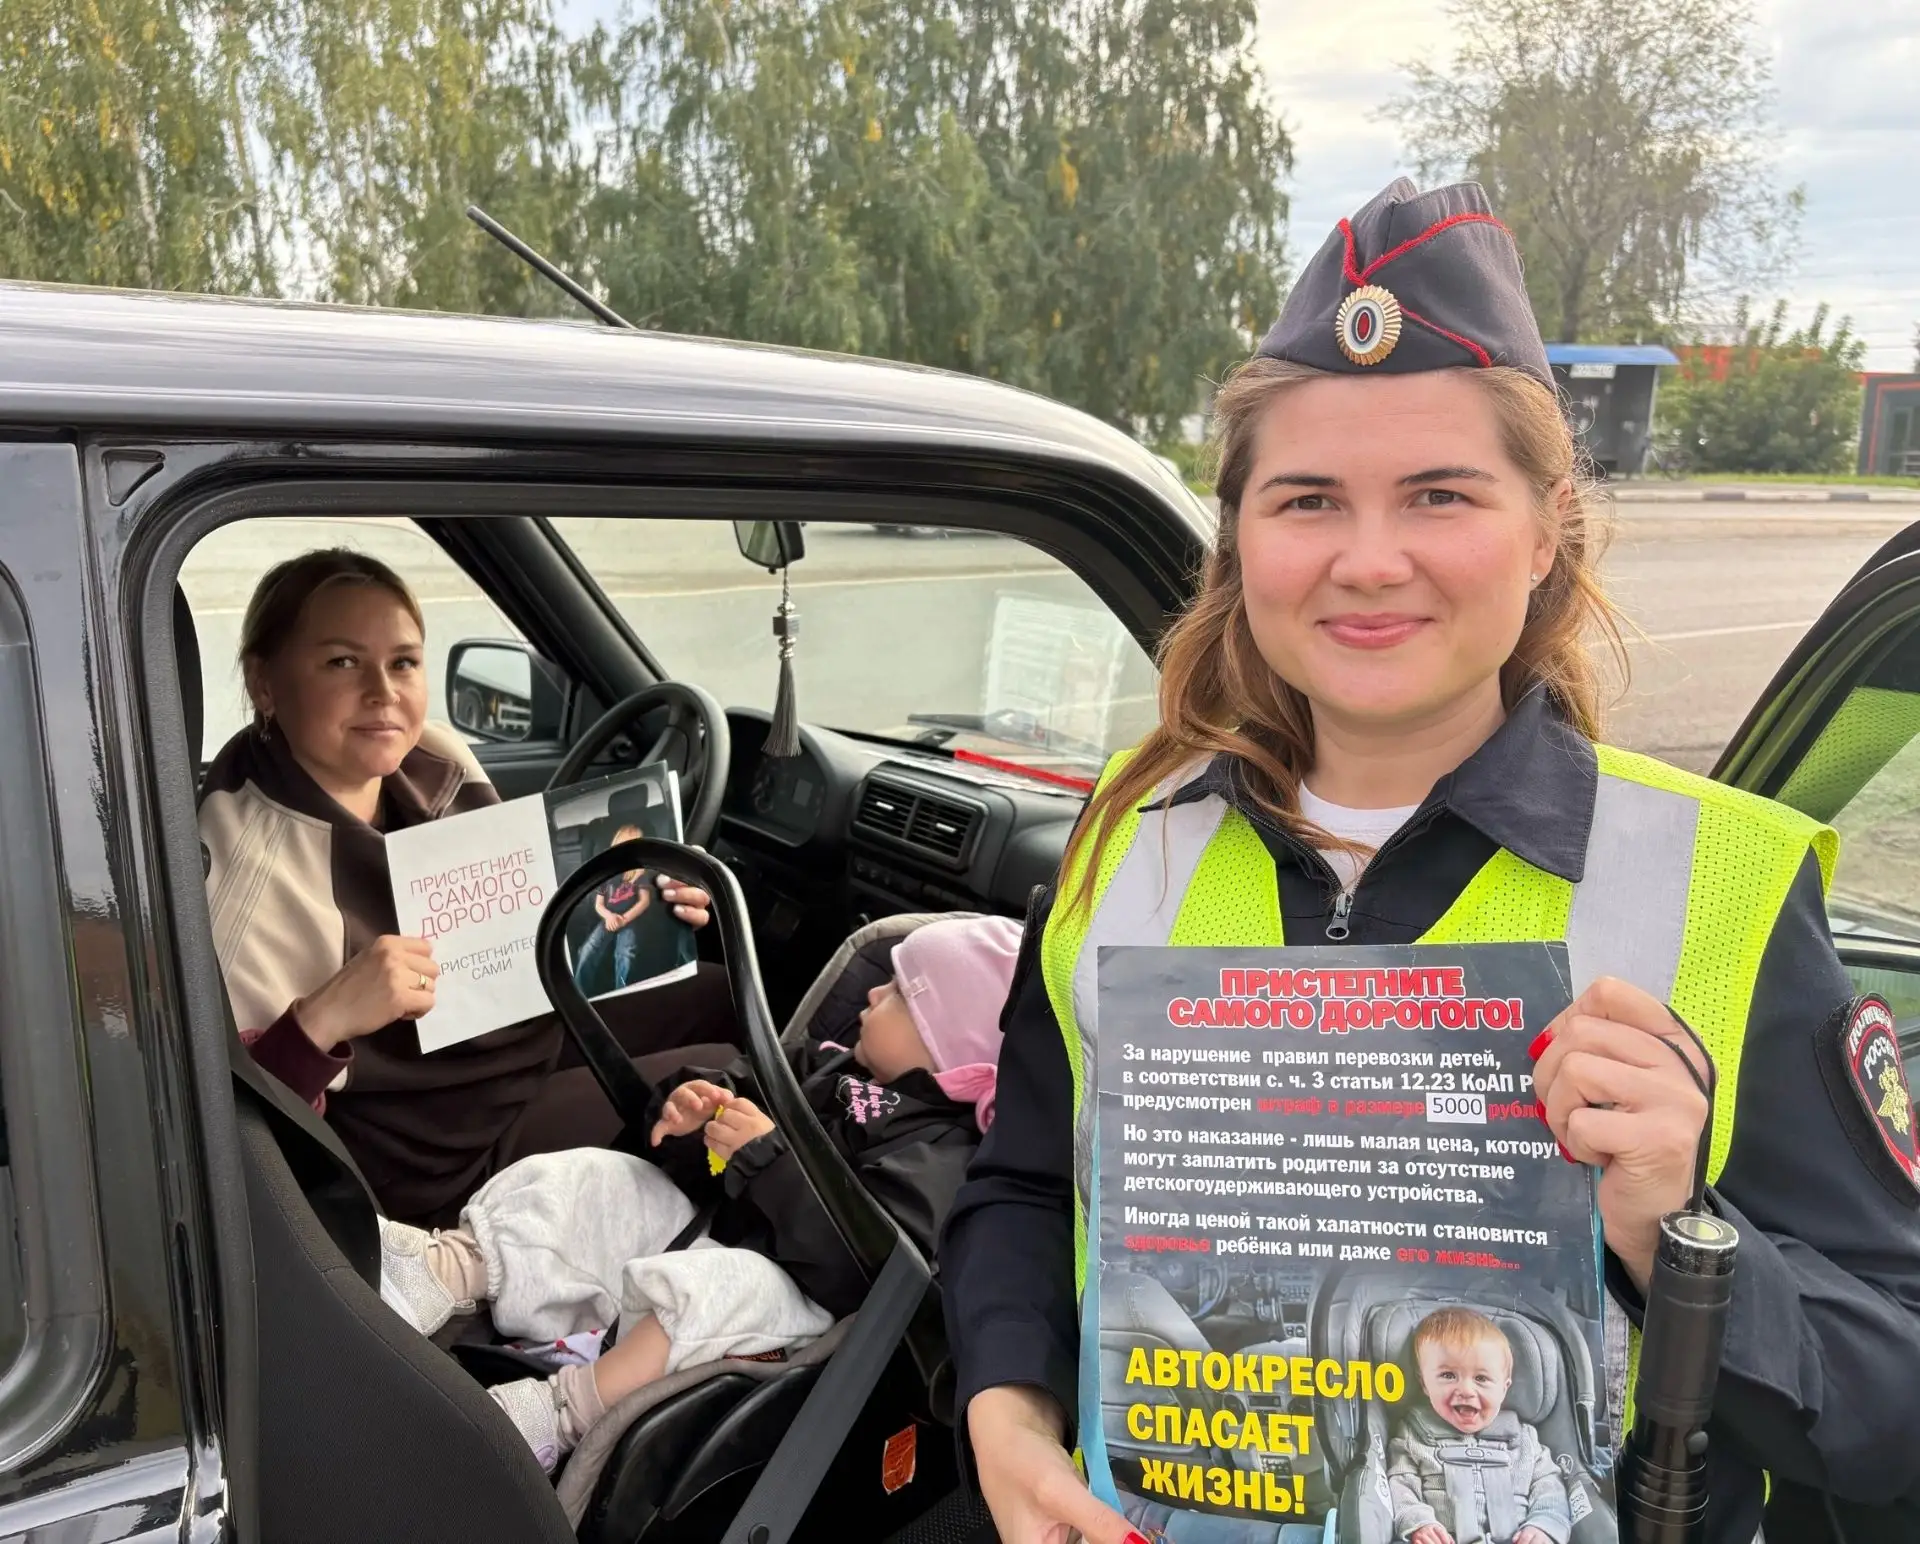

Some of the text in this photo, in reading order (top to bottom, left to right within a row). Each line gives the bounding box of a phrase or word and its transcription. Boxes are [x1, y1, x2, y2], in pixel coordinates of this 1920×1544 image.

[410, 848, 535, 897] ПРИСТЕГНИТЕ
[428, 868, 527, 913] САМОГО
[421, 886, 543, 940] ДОРОГОГО
[439, 935, 537, 975] РИСТЕГНИТЕС
[472, 957, 513, 980] САМИ
[1220, 966, 1466, 998] ПРИСТЕГНИТЕ
[1168, 997, 1524, 1034] САМОГО ДОРОГОГО!
[1123, 1043, 1502, 1070] За нарушение правил перевозки детей,
[1123, 1071, 1534, 1093] в соответствии с. ч. 3 статьи 12.23 КоАП Р
[1123, 1093, 1540, 1120] предусмотрен штраф в размере 5000 рубл
[1123, 1124, 1147, 1142] Но
[1152, 1128, 1183, 1143] это
[1188, 1130, 1285, 1146] наказание
[1302, 1134, 1355, 1149] лишь
[1360, 1135, 1421, 1151] малая
[1426, 1137, 1480, 1156] цена,
[1123, 1152, 1516, 1180] могут заплатить родители за отсутствие
[1124, 1175, 1484, 1205] детскогоудерживающего устройства.
[1124, 1206, 1548, 1246] Иногда ценой такой халатности становится
[1124, 1234, 1211, 1253] здоровье
[1216, 1236, 1292, 1256] ребёнка
[1298, 1242, 1334, 1258] или
[1339, 1244, 1392, 1261] даже
[1397, 1247, 1430, 1263] его
[1125, 1347, 1405, 1403] АВТОКРЕСЛО
[1127, 1403, 1315, 1456] СПАСАЕТ
[1139, 1456, 1305, 1515] ЖИЗНЬ!
